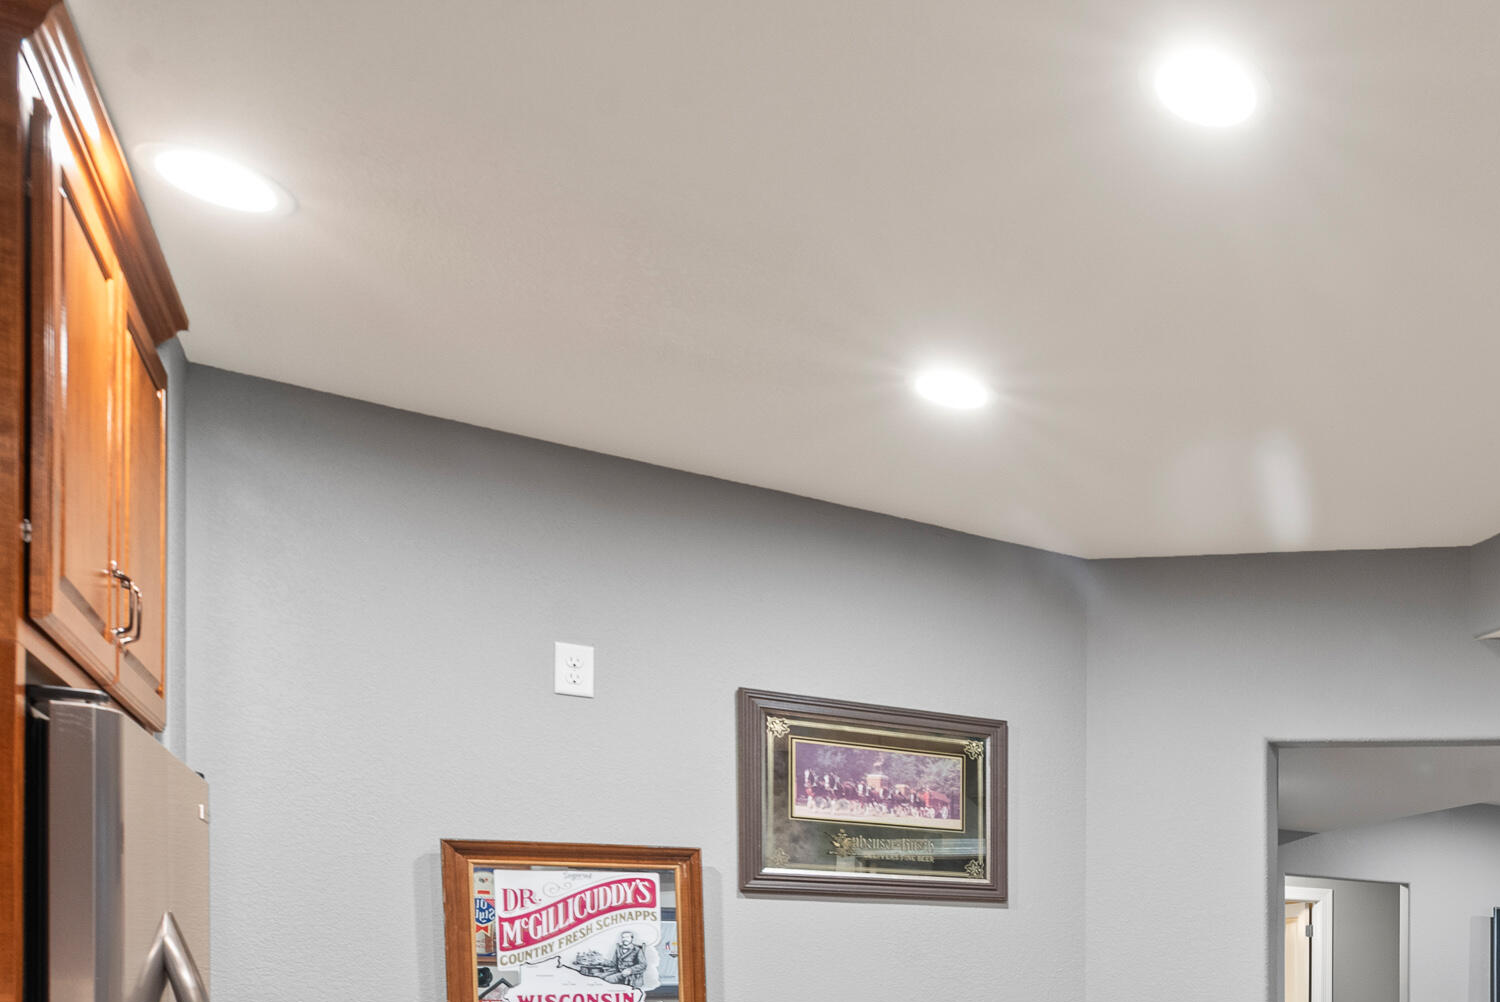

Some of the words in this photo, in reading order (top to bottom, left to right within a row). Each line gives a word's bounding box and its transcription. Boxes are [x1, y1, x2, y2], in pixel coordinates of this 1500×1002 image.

[501, 888, 543, 912] DR.
[500, 942, 556, 966] COUNTRY
[557, 923, 594, 949] FRESH
[596, 910, 658, 931] SCHNAPPS
